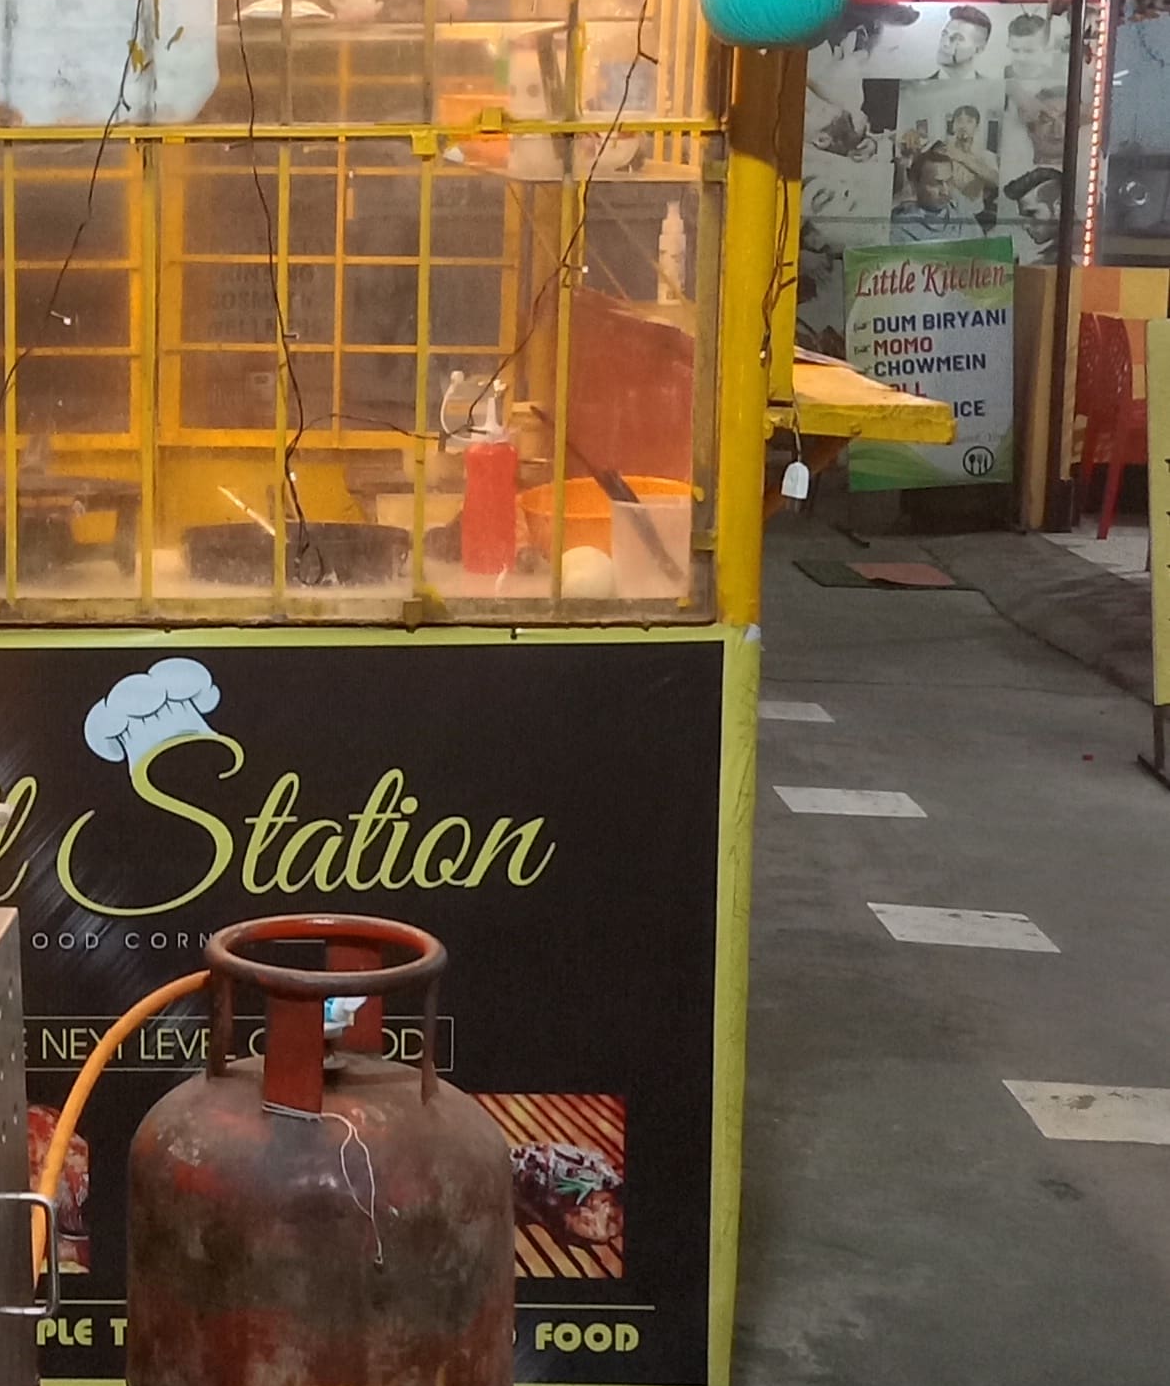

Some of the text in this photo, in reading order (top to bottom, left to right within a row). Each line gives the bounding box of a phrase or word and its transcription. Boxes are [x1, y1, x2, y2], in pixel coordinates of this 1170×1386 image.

[855, 258, 1006, 298] Little Kitchen
[873, 308, 1007, 334] DUM BIRYANI
[873, 336, 934, 357] MOMO
[874, 353, 987, 377] CHOWMEIN
[953, 399, 987, 419] ICE
[56, 732, 557, 917] Station
[31, 931, 216, 951] OOD CORN
[139, 1027, 237, 1060] LEVE
[534, 1321, 641, 1353] FOOD
